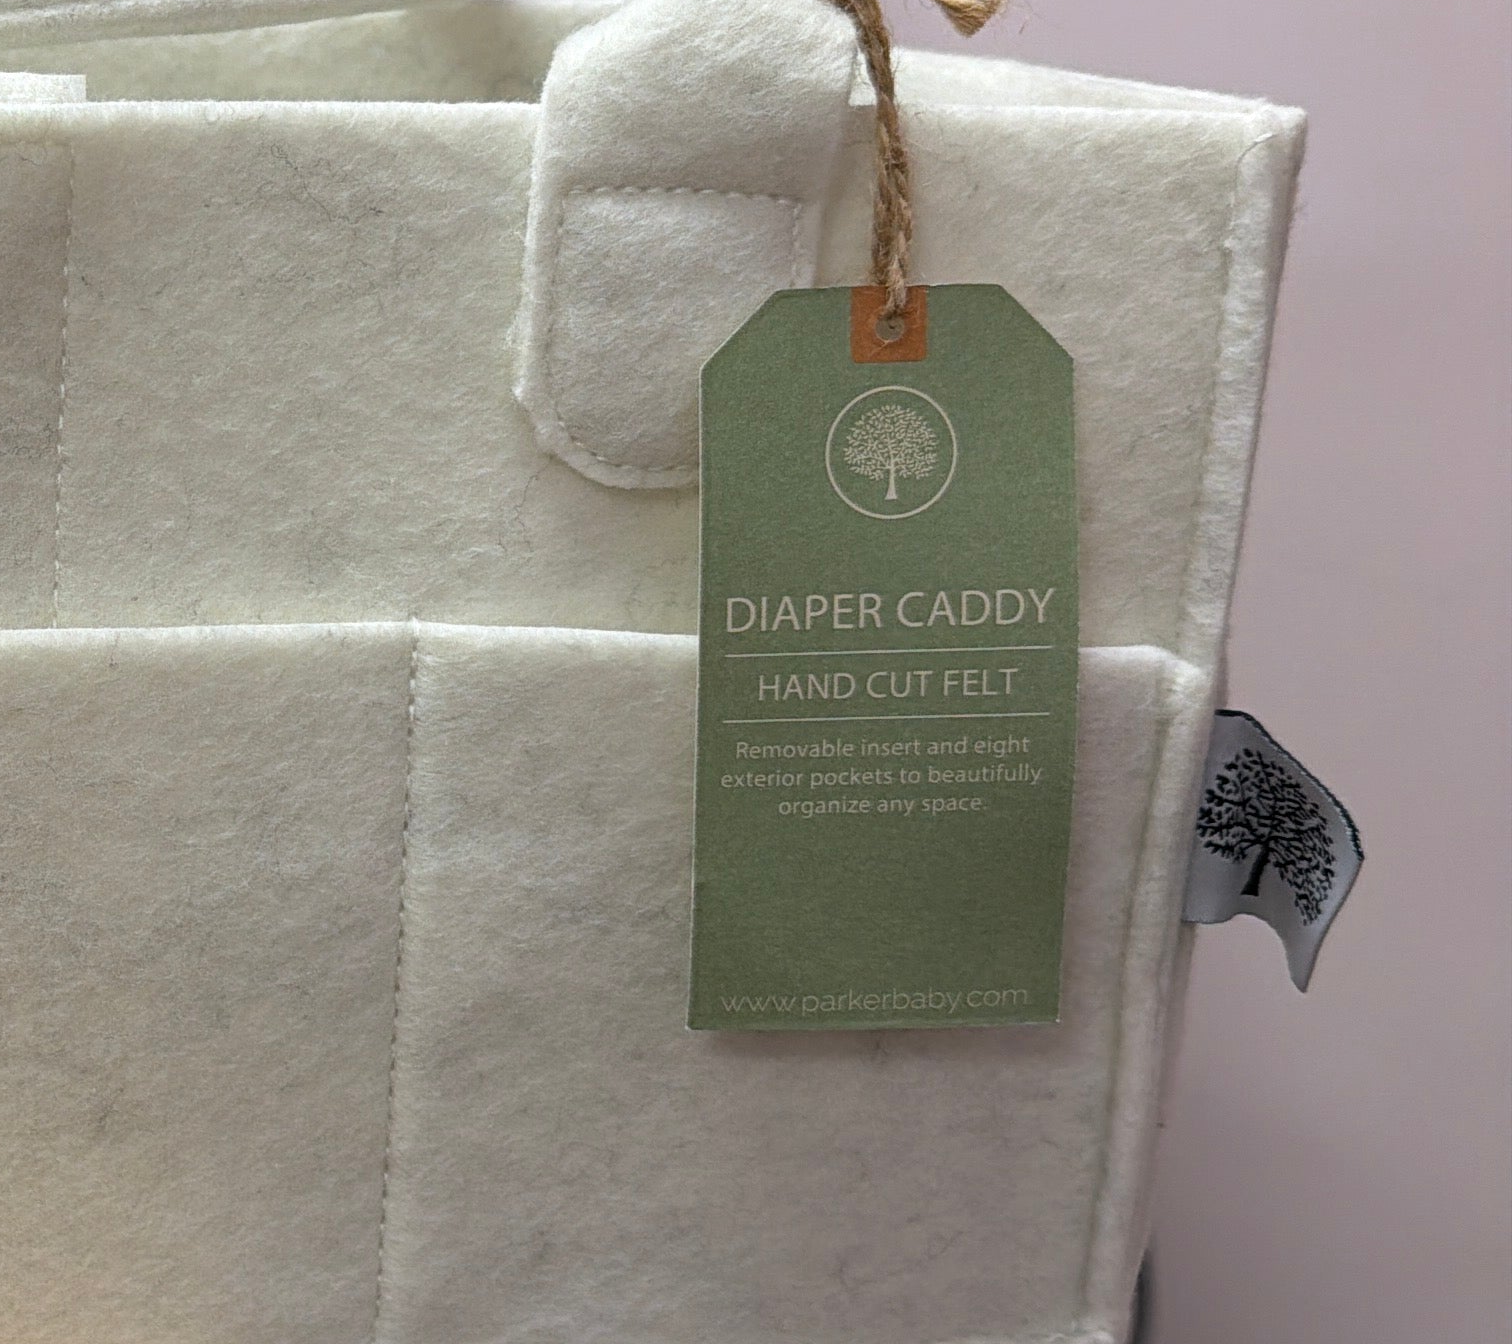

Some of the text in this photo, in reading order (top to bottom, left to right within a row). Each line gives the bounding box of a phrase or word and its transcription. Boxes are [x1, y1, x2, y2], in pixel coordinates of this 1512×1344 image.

[726, 587, 1055, 633] DIAPER CADDY
[758, 667, 1019, 701] HAND CUT FELT
[735, 734, 1030, 760] Removable insert and eight
[720, 763, 1043, 789] exterior pockets to beautifully
[778, 794, 987, 819] organize any space.
[720, 987, 1028, 1017] wwwparkerbabycom
